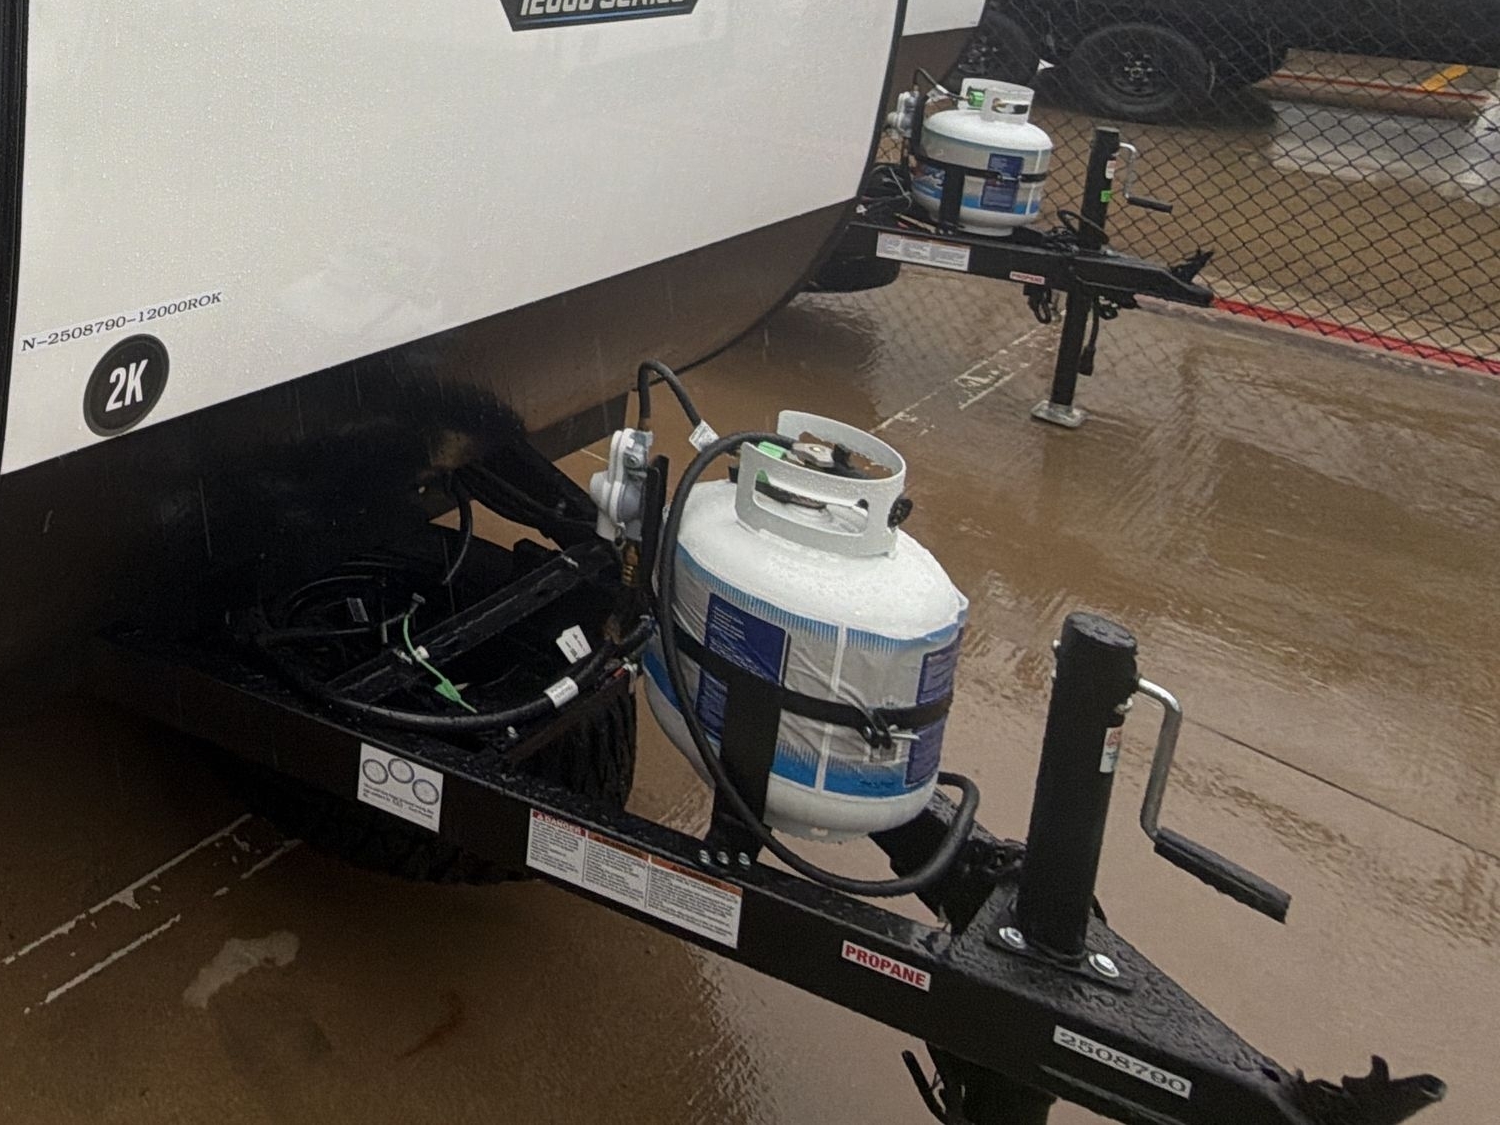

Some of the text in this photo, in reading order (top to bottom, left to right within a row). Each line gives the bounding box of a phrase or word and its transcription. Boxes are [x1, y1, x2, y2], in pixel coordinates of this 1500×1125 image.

[105, 359, 149, 413] 2K
[544, 816, 582, 835] DANGER
[845, 943, 927, 987] PROPANE
[1059, 1031, 1187, 1093] 2508790
